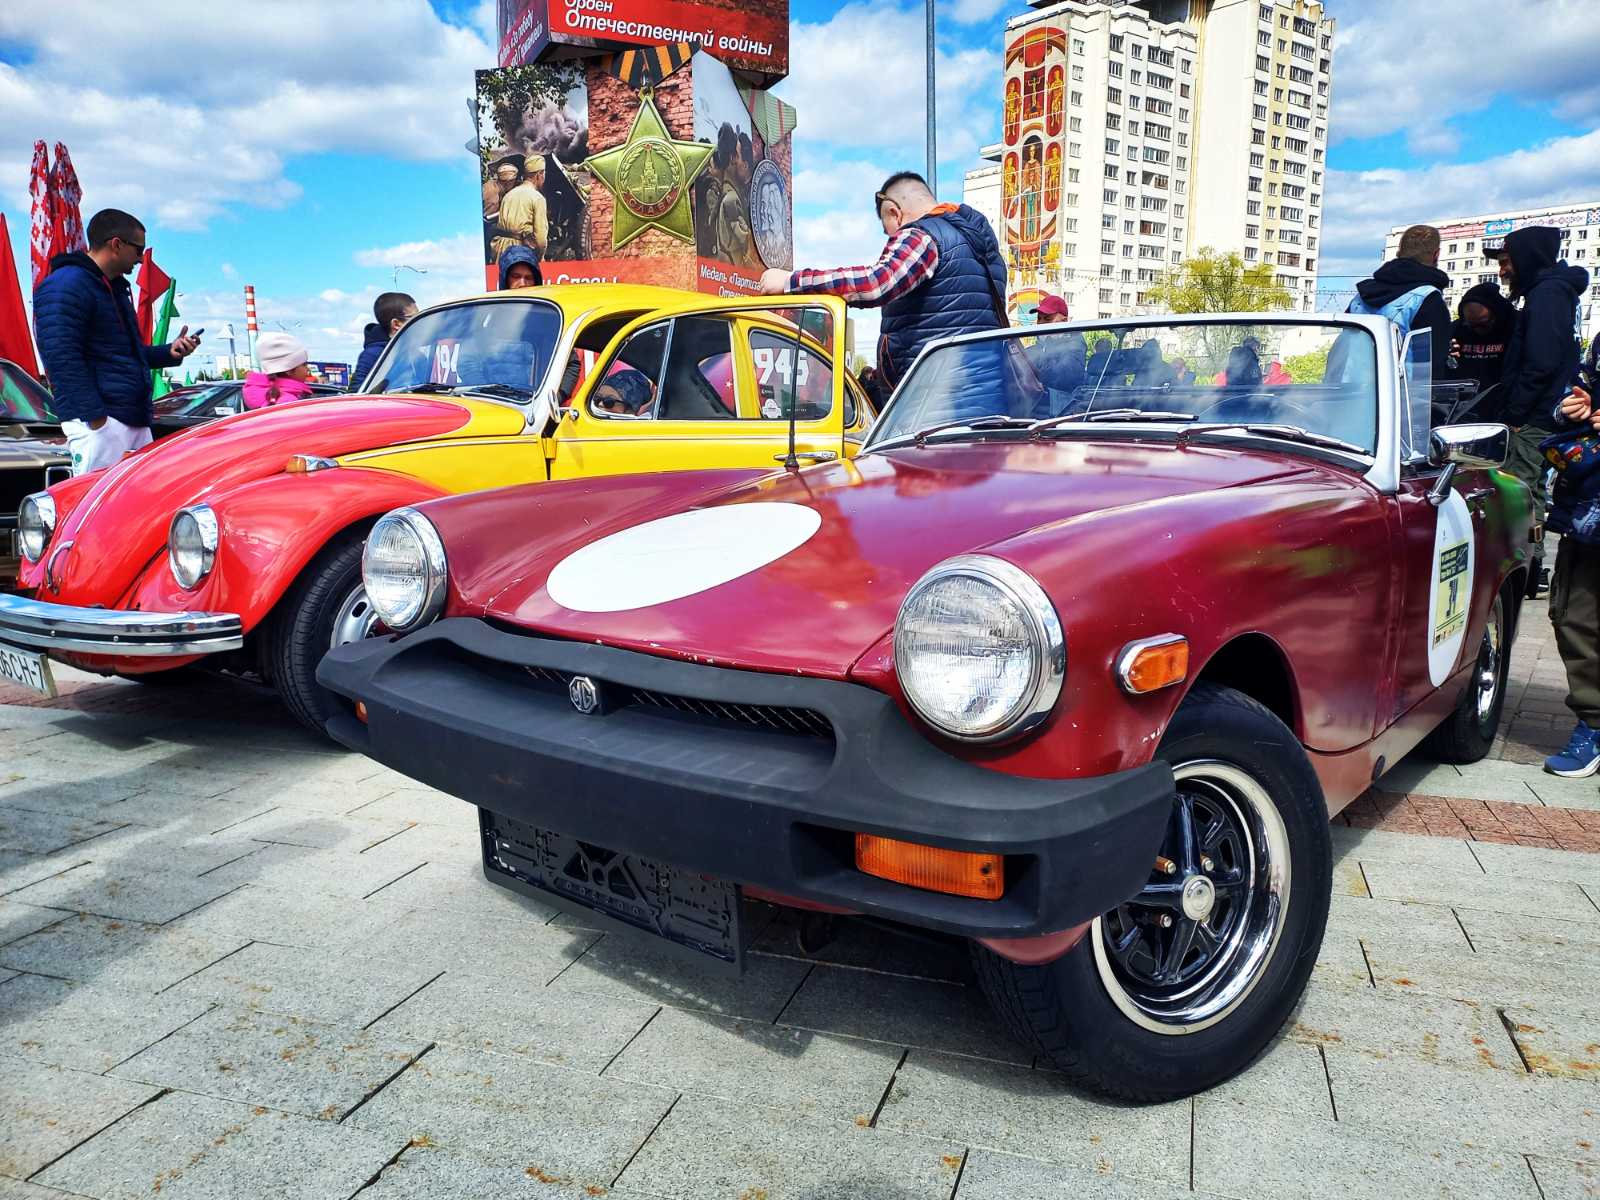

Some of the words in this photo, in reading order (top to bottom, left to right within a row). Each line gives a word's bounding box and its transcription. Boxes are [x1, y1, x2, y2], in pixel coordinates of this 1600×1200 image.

[565, 9, 714, 47] Отечественной
[718, 35, 773, 57] войны
[700, 263, 728, 283] Медаль
